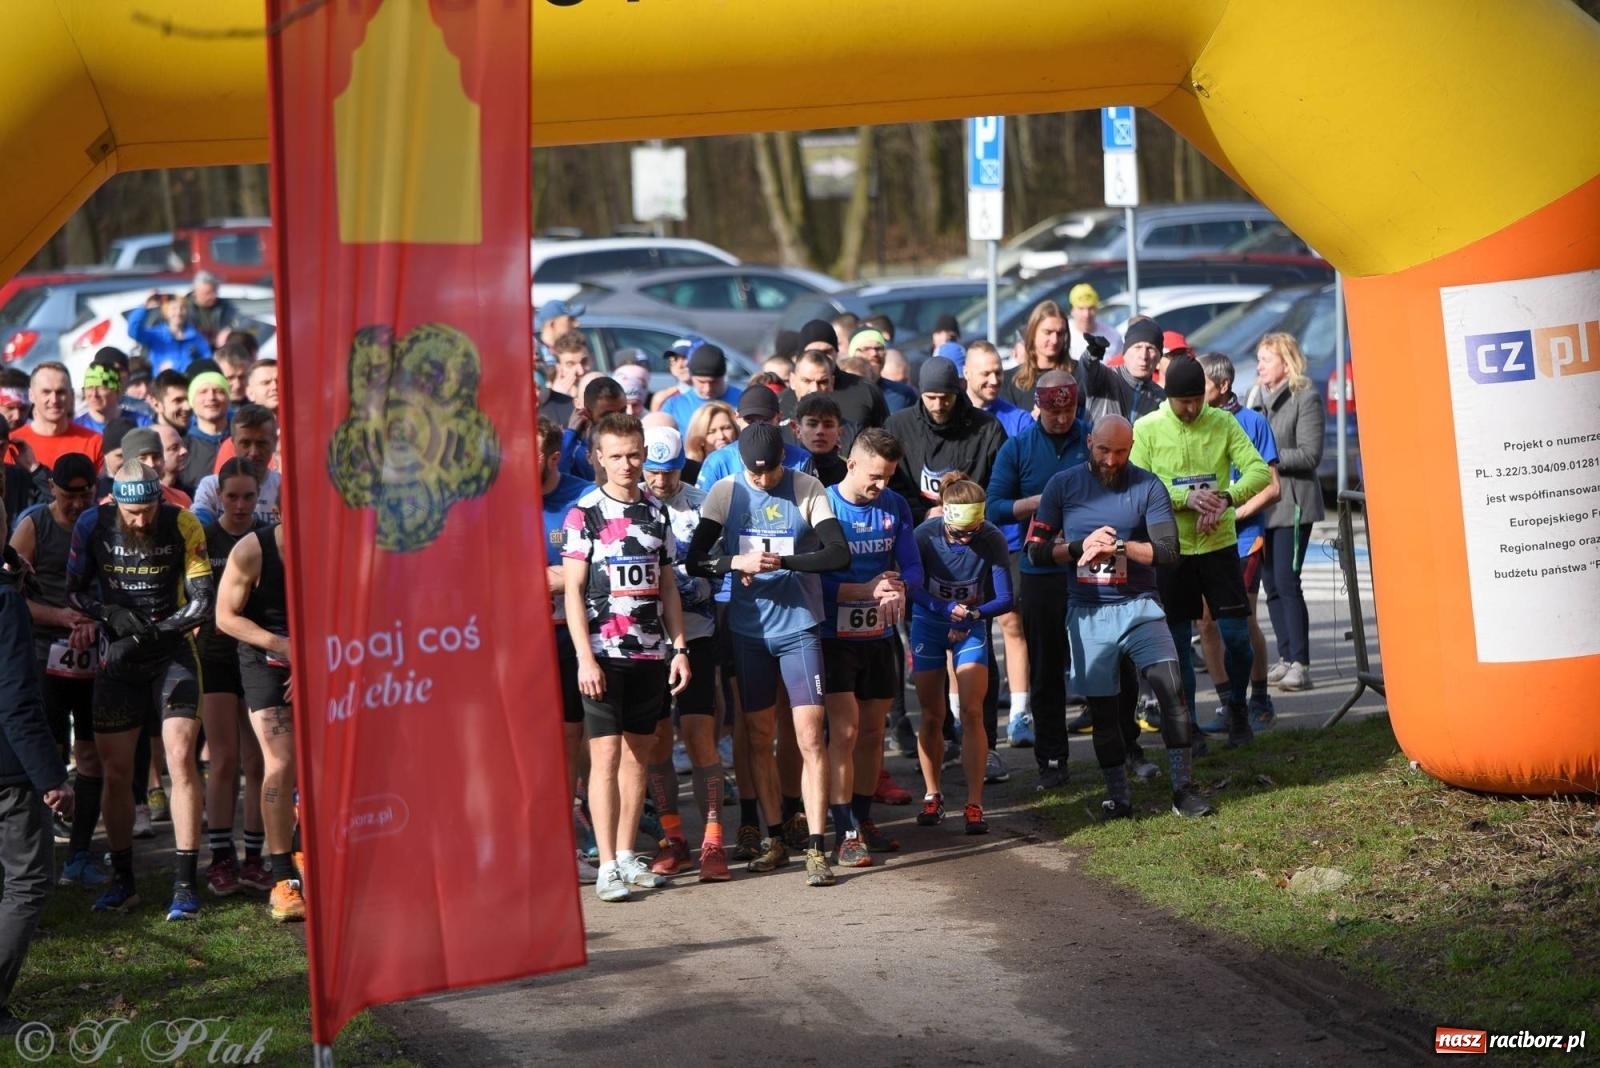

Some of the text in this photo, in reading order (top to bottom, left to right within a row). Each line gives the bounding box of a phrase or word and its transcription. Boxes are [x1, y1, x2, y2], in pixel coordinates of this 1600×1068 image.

[1477, 341, 1526, 374] cz
[1503, 439, 1543, 452] Projekt
[1475, 468, 1493, 478] PL.
[1486, 494, 1507, 506] jest
[1509, 513, 1589, 528] Europejskiego
[1500, 540, 1576, 555] Regionalnego
[616, 564, 656, 587] 105
[1494, 567, 1538, 579] budżetu
[1541, 564, 1587, 578] państwa
[850, 608, 878, 629] 66
[418, 614, 481, 654] coś
[60, 648, 90, 670] 40
